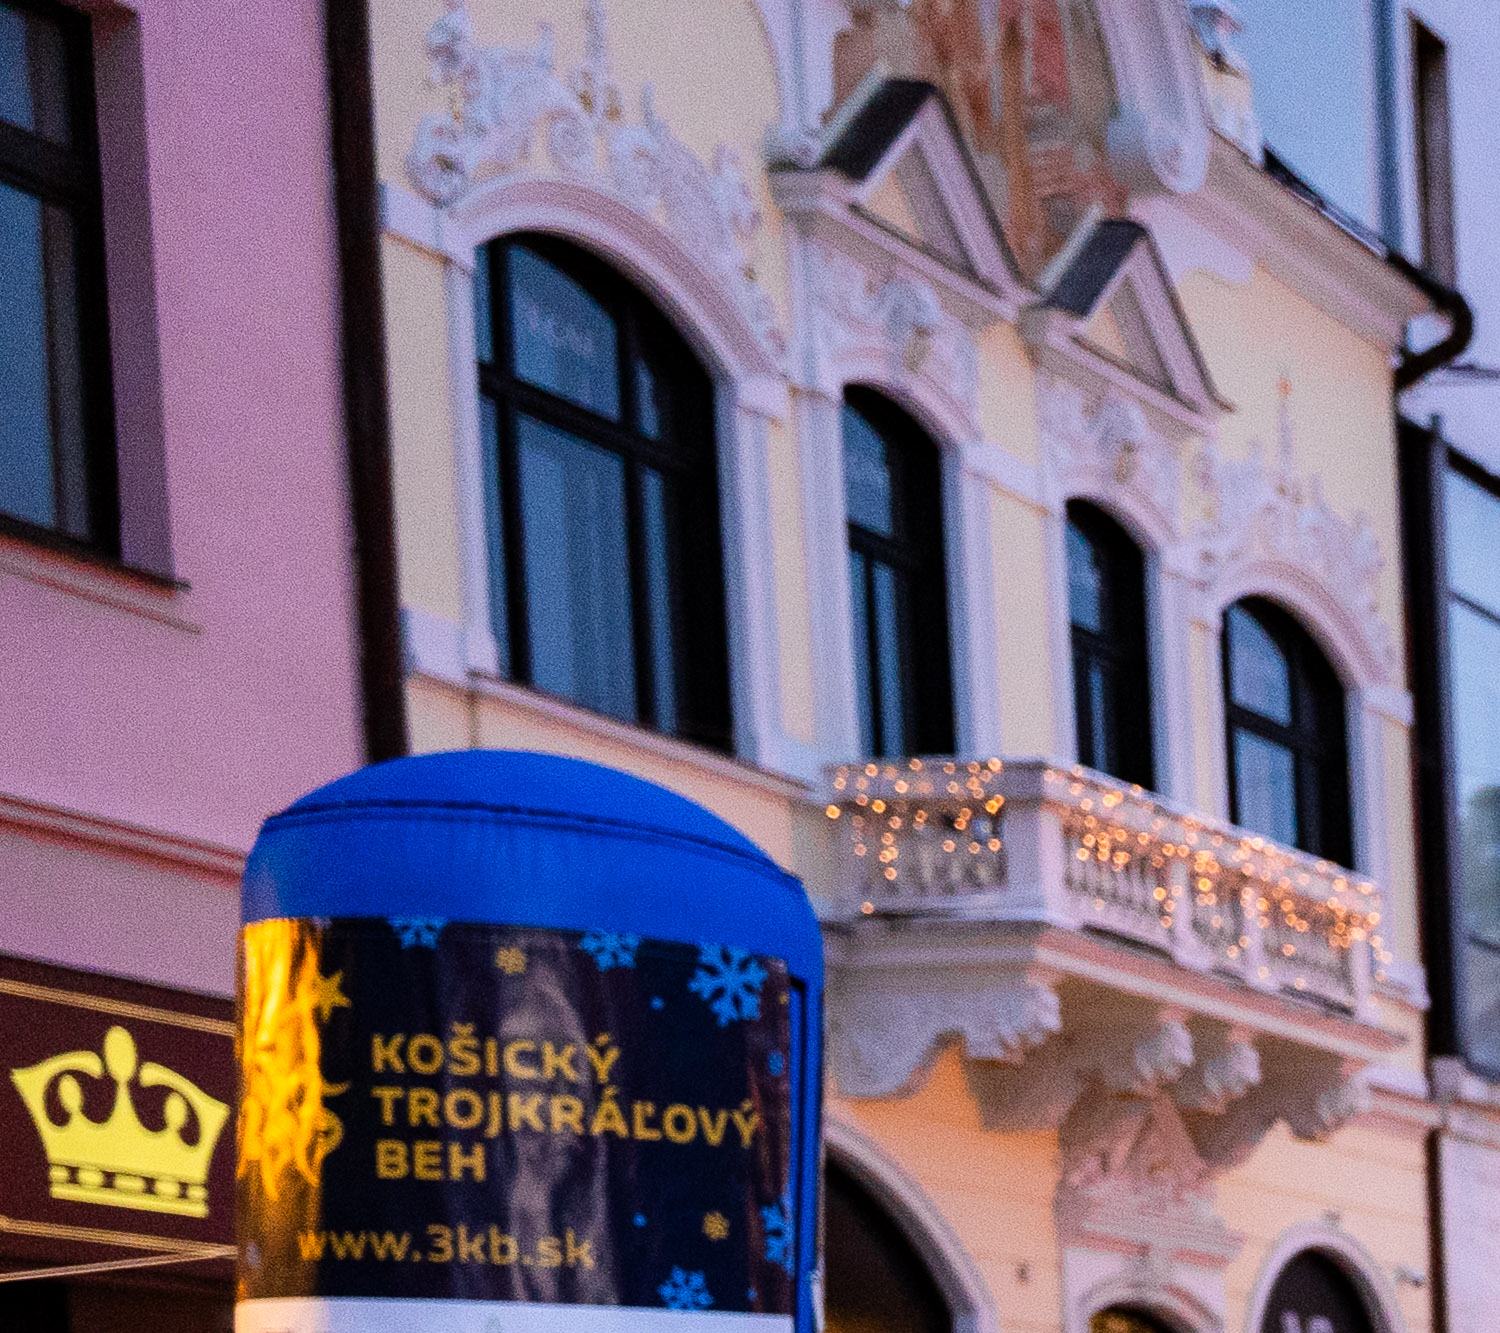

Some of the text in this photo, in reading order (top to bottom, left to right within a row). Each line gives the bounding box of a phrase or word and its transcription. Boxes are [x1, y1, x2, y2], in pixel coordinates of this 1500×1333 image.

[371, 1023, 622, 1083] KOŠICKÝ
[370, 1085, 761, 1150] TROJKRÁĽOVÝ
[375, 1139, 487, 1182] BEH
[298, 1225, 596, 1269] www.3kb.sk
